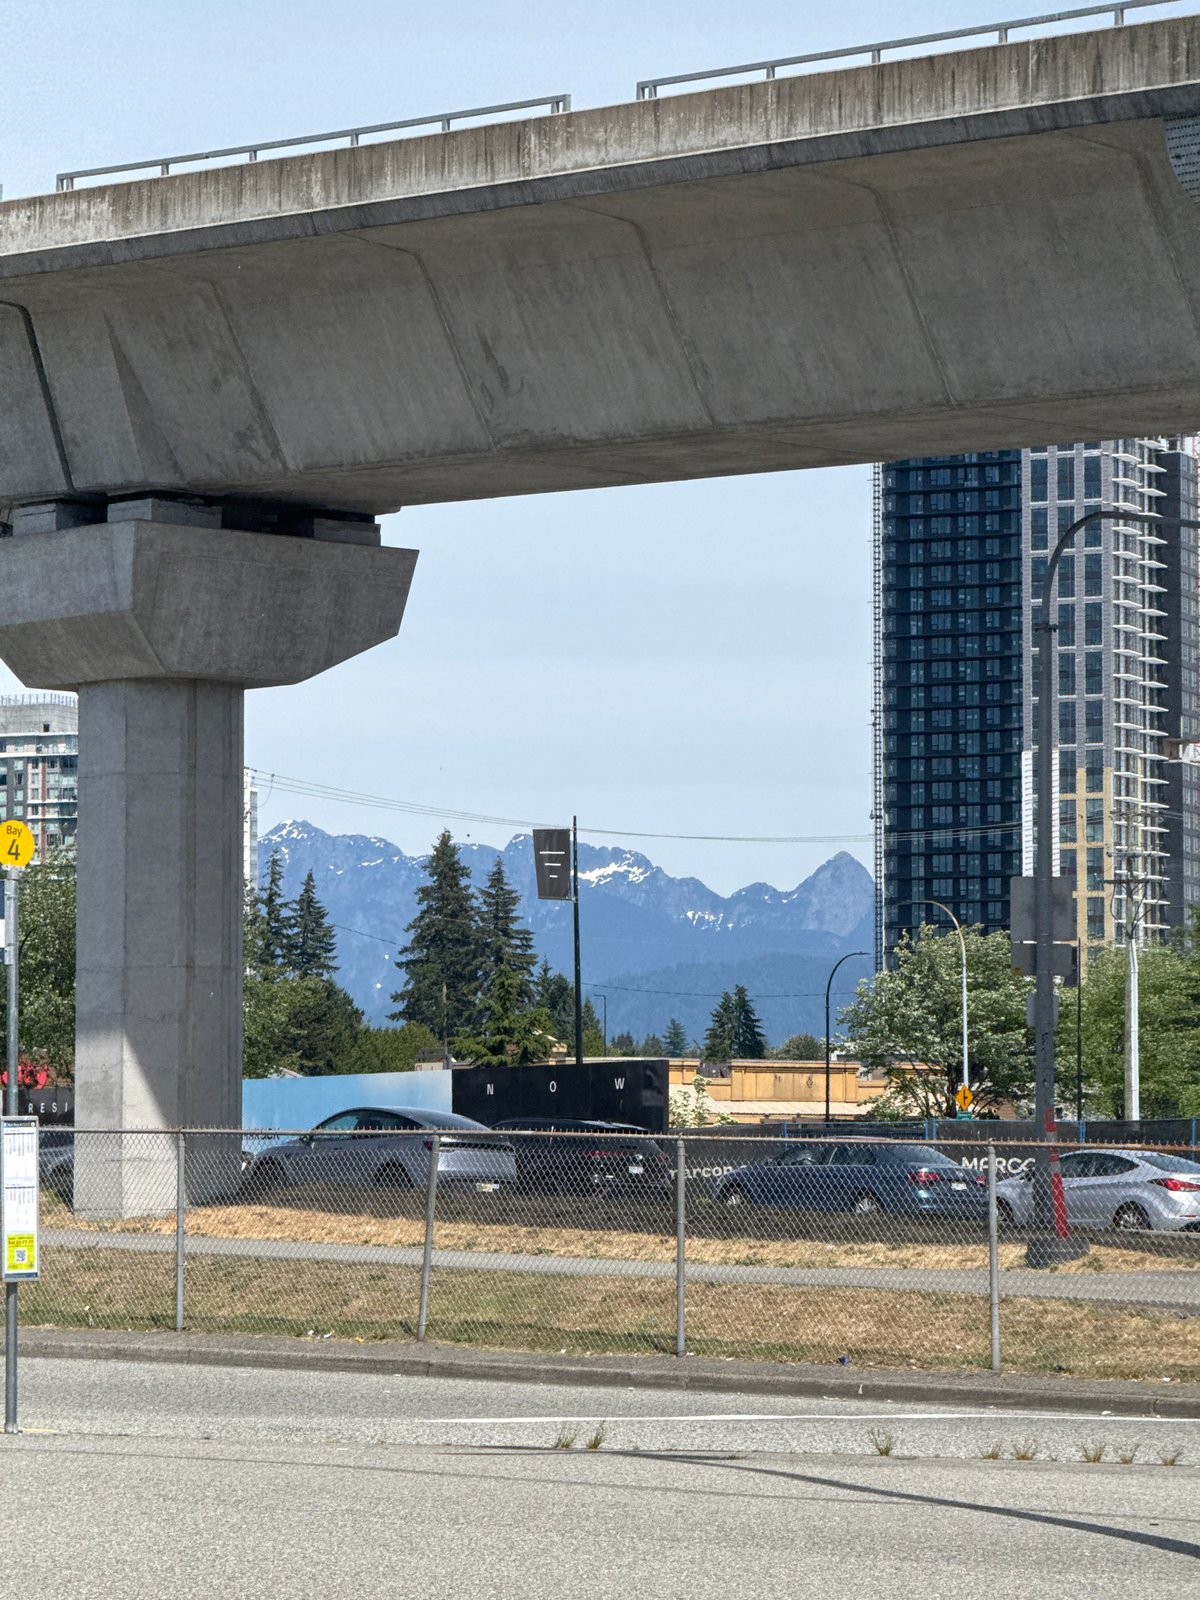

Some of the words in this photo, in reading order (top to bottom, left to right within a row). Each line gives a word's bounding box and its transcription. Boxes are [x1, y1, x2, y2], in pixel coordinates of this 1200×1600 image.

[6, 825, 22, 838] Bay
[7, 838, 21, 861] 4
[28, 1102, 68, 1114] RESI
